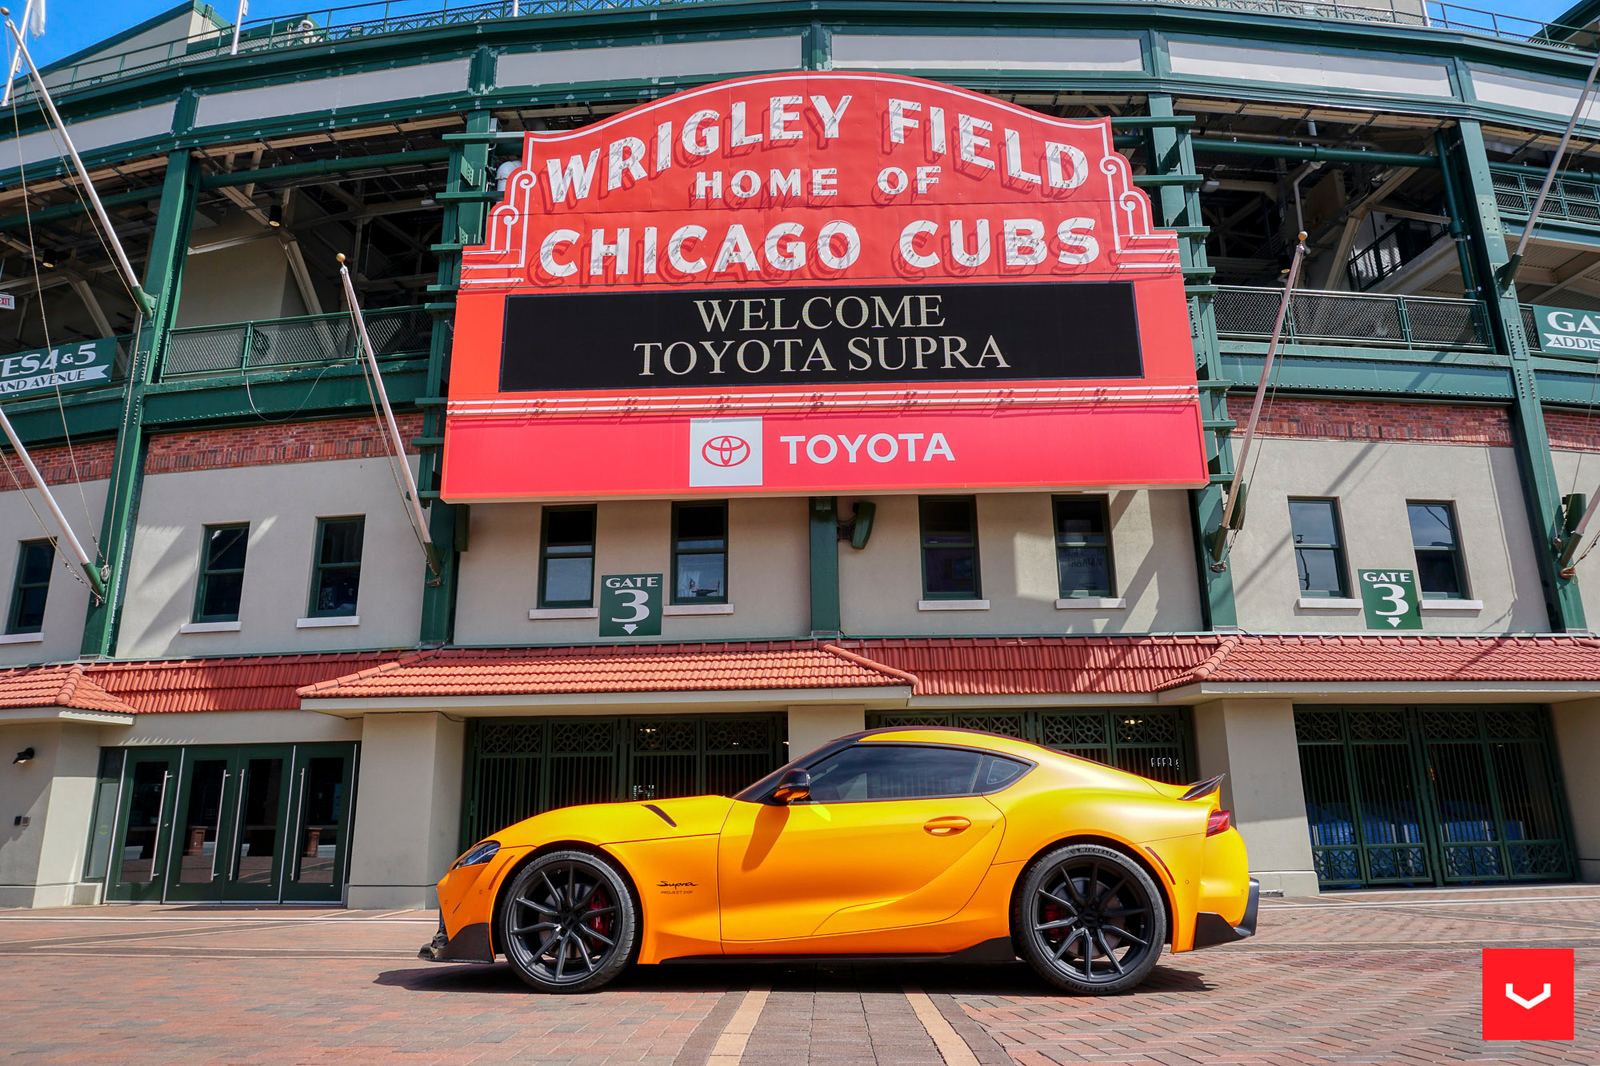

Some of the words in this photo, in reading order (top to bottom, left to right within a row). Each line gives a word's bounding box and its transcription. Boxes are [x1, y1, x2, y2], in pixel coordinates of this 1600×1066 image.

[546, 95, 852, 203] WRIGLEY
[888, 99, 1088, 189] FIELD
[695, 168, 837, 199] HOME
[877, 166, 941, 194] OF
[540, 220, 861, 277] CHICAGO
[900, 217, 1099, 268] CUBS
[693, 294, 946, 333] WELCOME
[633, 337, 836, 376] TOYOTA
[847, 334, 1011, 371] SUPRA
[30, 369, 86, 388] AVENUE
[780, 432, 955, 464] TOYOTA
[605, 577, 658, 588] GATE
[1363, 572, 1411, 582] GATE
[611, 589, 650, 622] 3
[1373, 583, 1409, 615] 3
[656, 880, 699, 890] Supra
